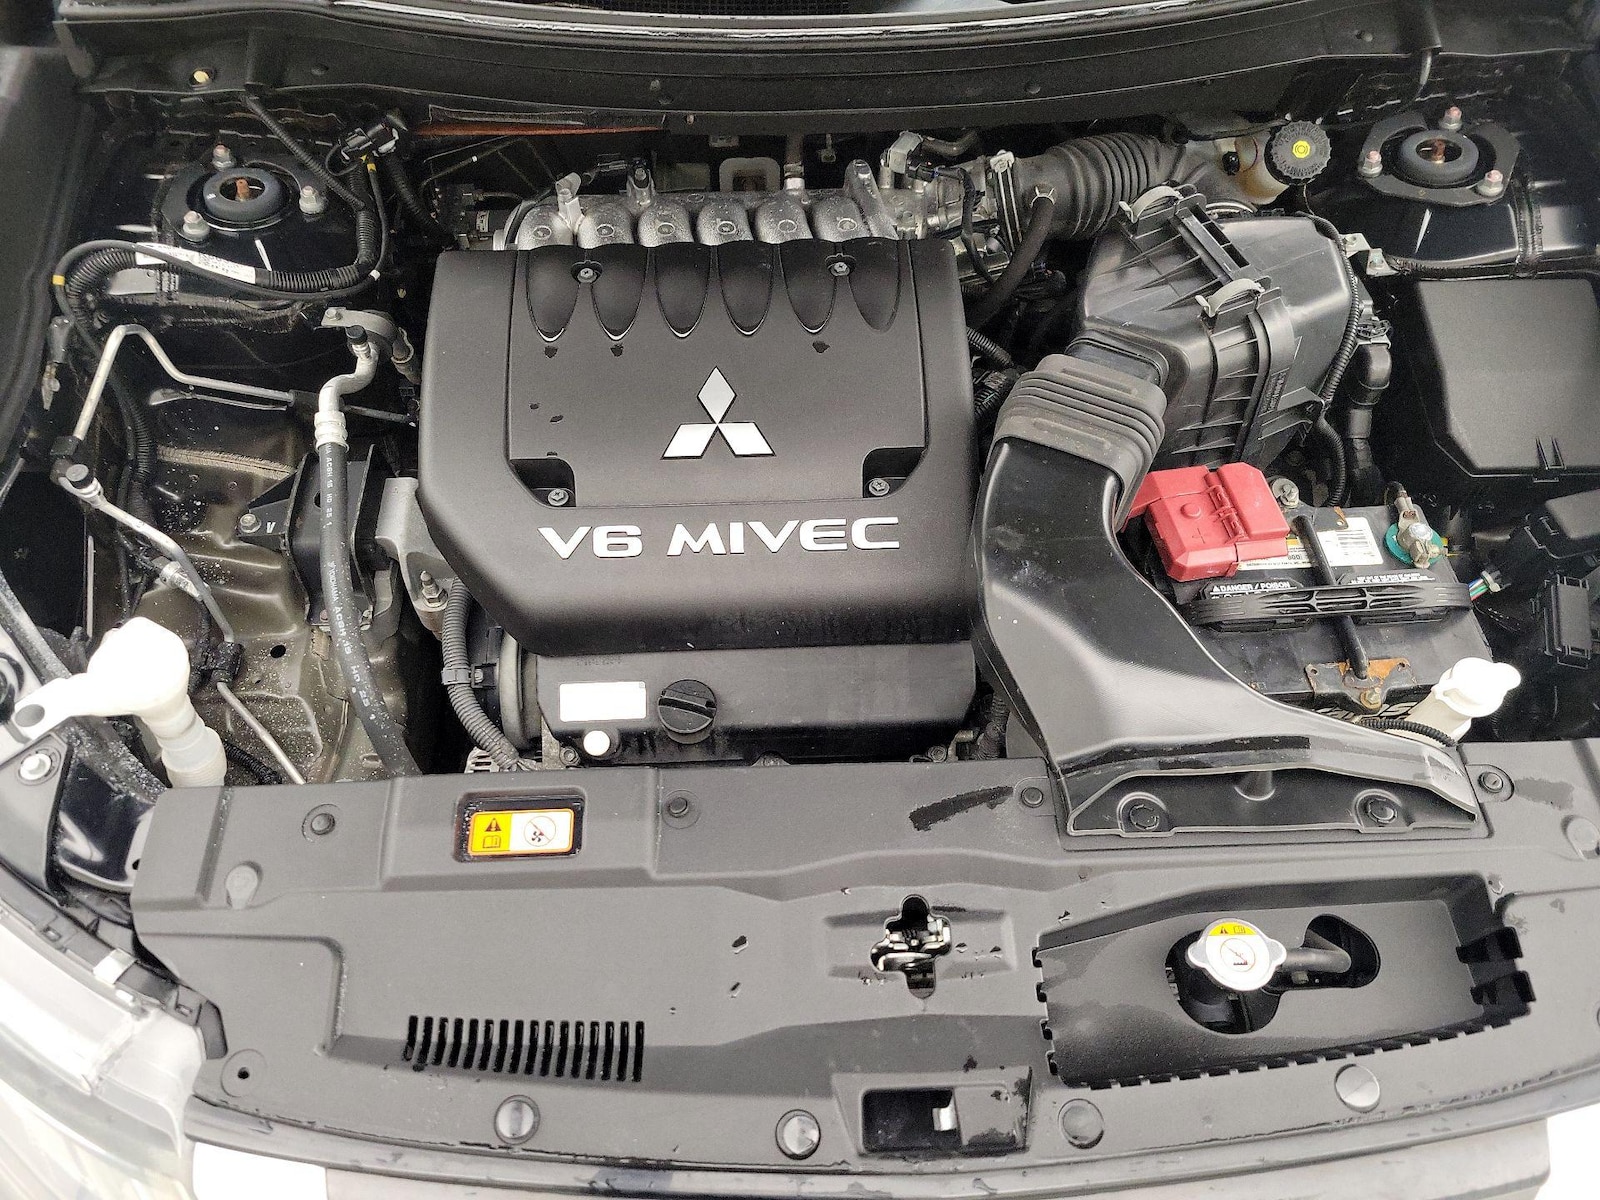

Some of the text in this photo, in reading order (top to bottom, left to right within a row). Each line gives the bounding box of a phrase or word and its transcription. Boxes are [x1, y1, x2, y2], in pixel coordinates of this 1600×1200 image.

[537, 516, 900, 560] V6 MIVEC
[1219, 583, 1254, 593] DANGER
[1261, 581, 1291, 590] POISON
